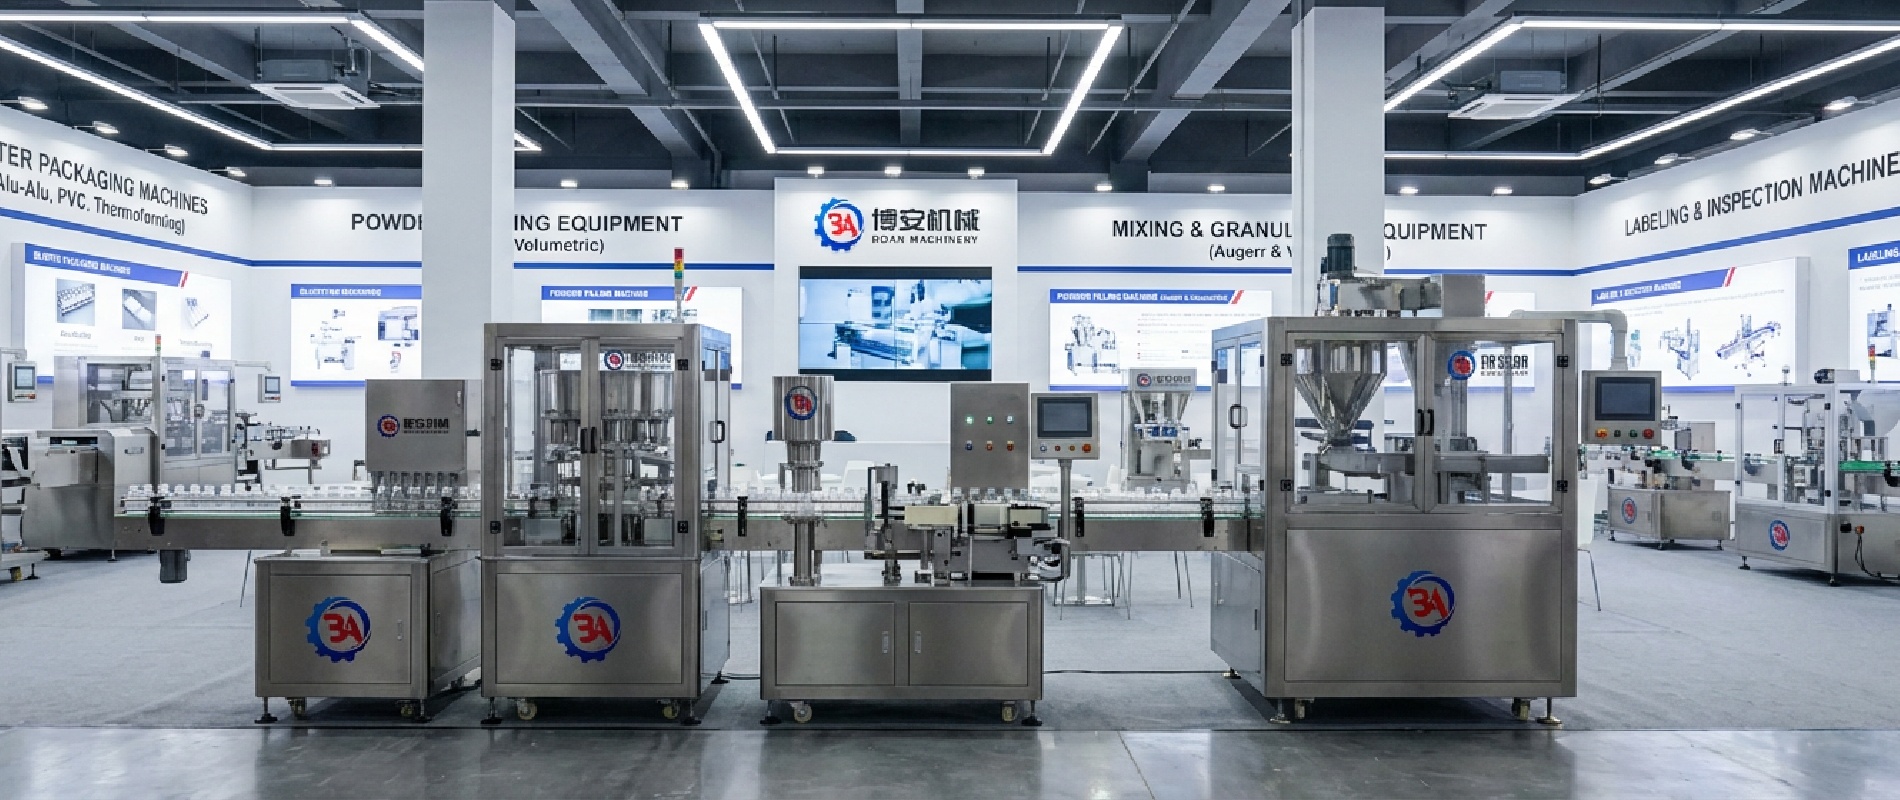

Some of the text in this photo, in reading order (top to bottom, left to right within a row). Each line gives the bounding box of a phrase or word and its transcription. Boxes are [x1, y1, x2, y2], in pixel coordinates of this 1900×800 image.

[39, 152, 134, 198] PACKAGING
[139, 180, 208, 215] MACHINES
[1625, 150, 1900, 236] LABELING & INSPECTION MACHINE
[557, 215, 684, 234] EQUIPMENT
[871, 208, 980, 232] 博安机械
[1112, 220, 1184, 238] MIXING
[1191, 220, 1204, 238] &
[1211, 221, 1292, 238] GRANUL
[514, 237, 605, 255] Volumetric)
[909, 235, 980, 245] MACHINERY
[1209, 244, 1267, 261] (Augerr
[1271, 244, 1281, 258] &
